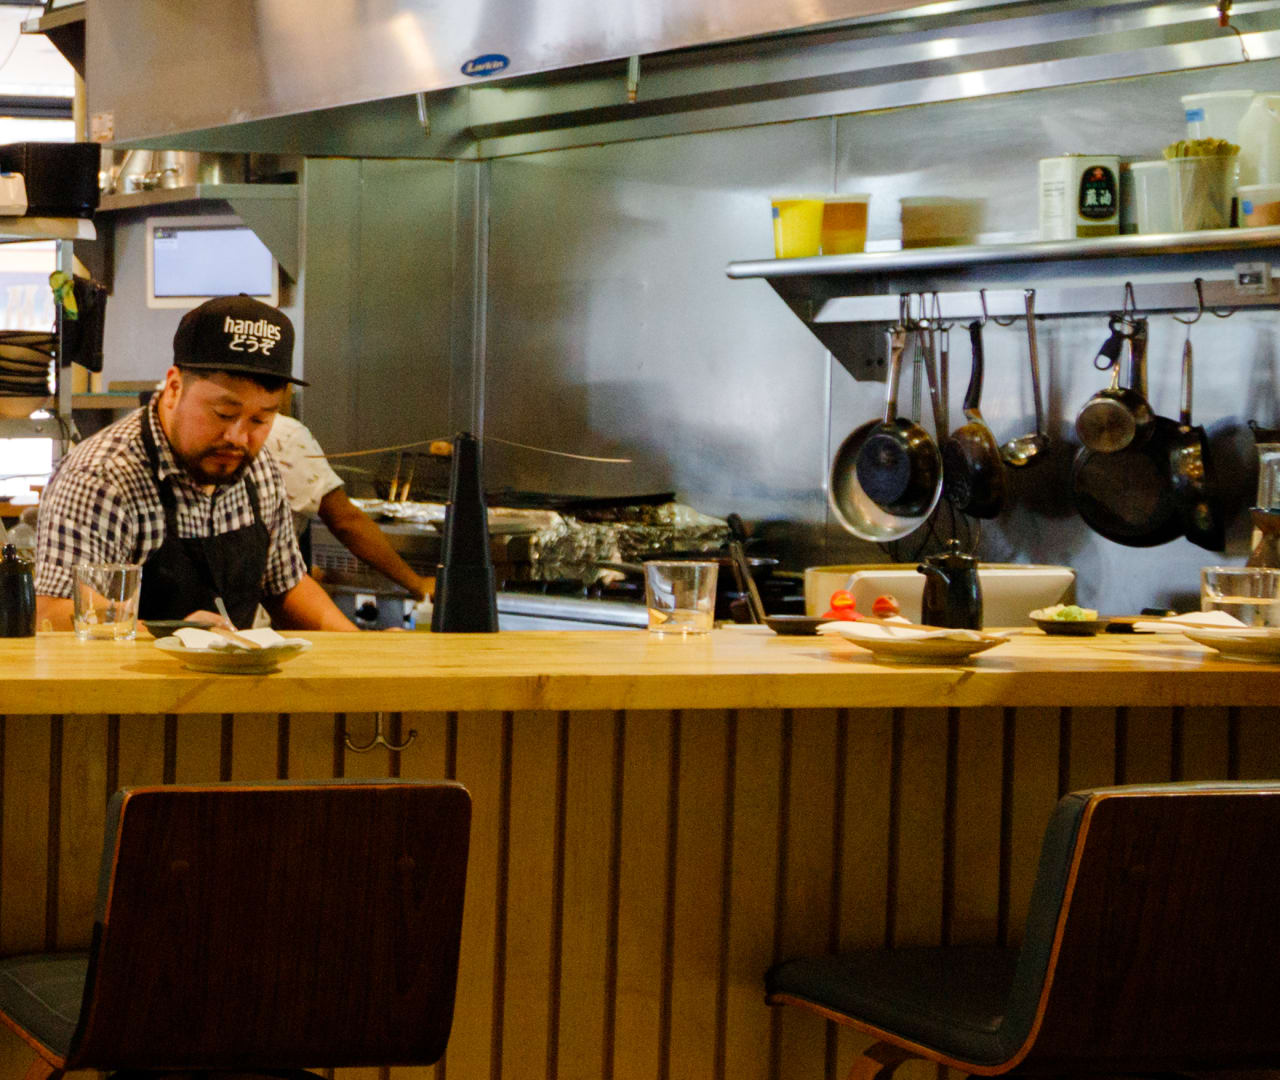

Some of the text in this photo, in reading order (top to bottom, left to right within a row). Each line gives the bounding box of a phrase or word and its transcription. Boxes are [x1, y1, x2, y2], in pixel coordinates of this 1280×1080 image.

[224, 315, 281, 340] handies
[229, 334, 276, 356] どうぞ
